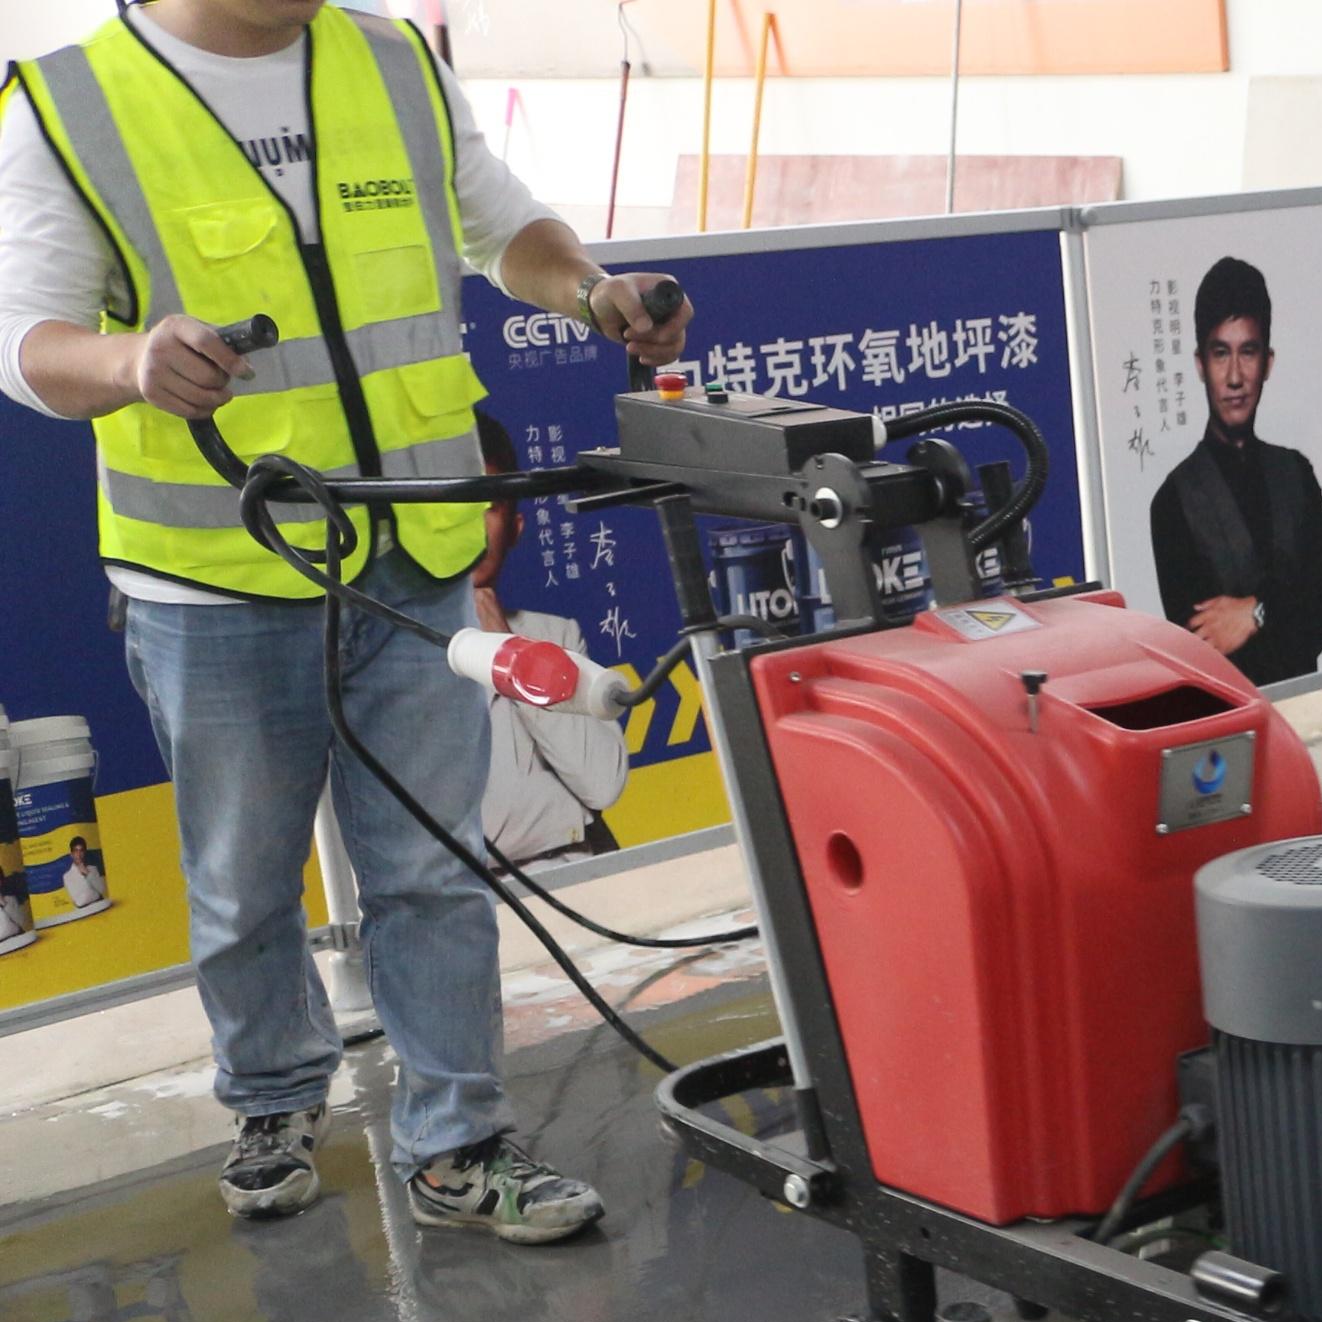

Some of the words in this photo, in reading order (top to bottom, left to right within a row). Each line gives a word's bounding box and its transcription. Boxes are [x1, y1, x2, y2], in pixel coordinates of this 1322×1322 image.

[338, 179, 413, 198] BAOBOL
[503, 312, 590, 349] CCTV
[526, 425, 559, 588] 力特象代言人
